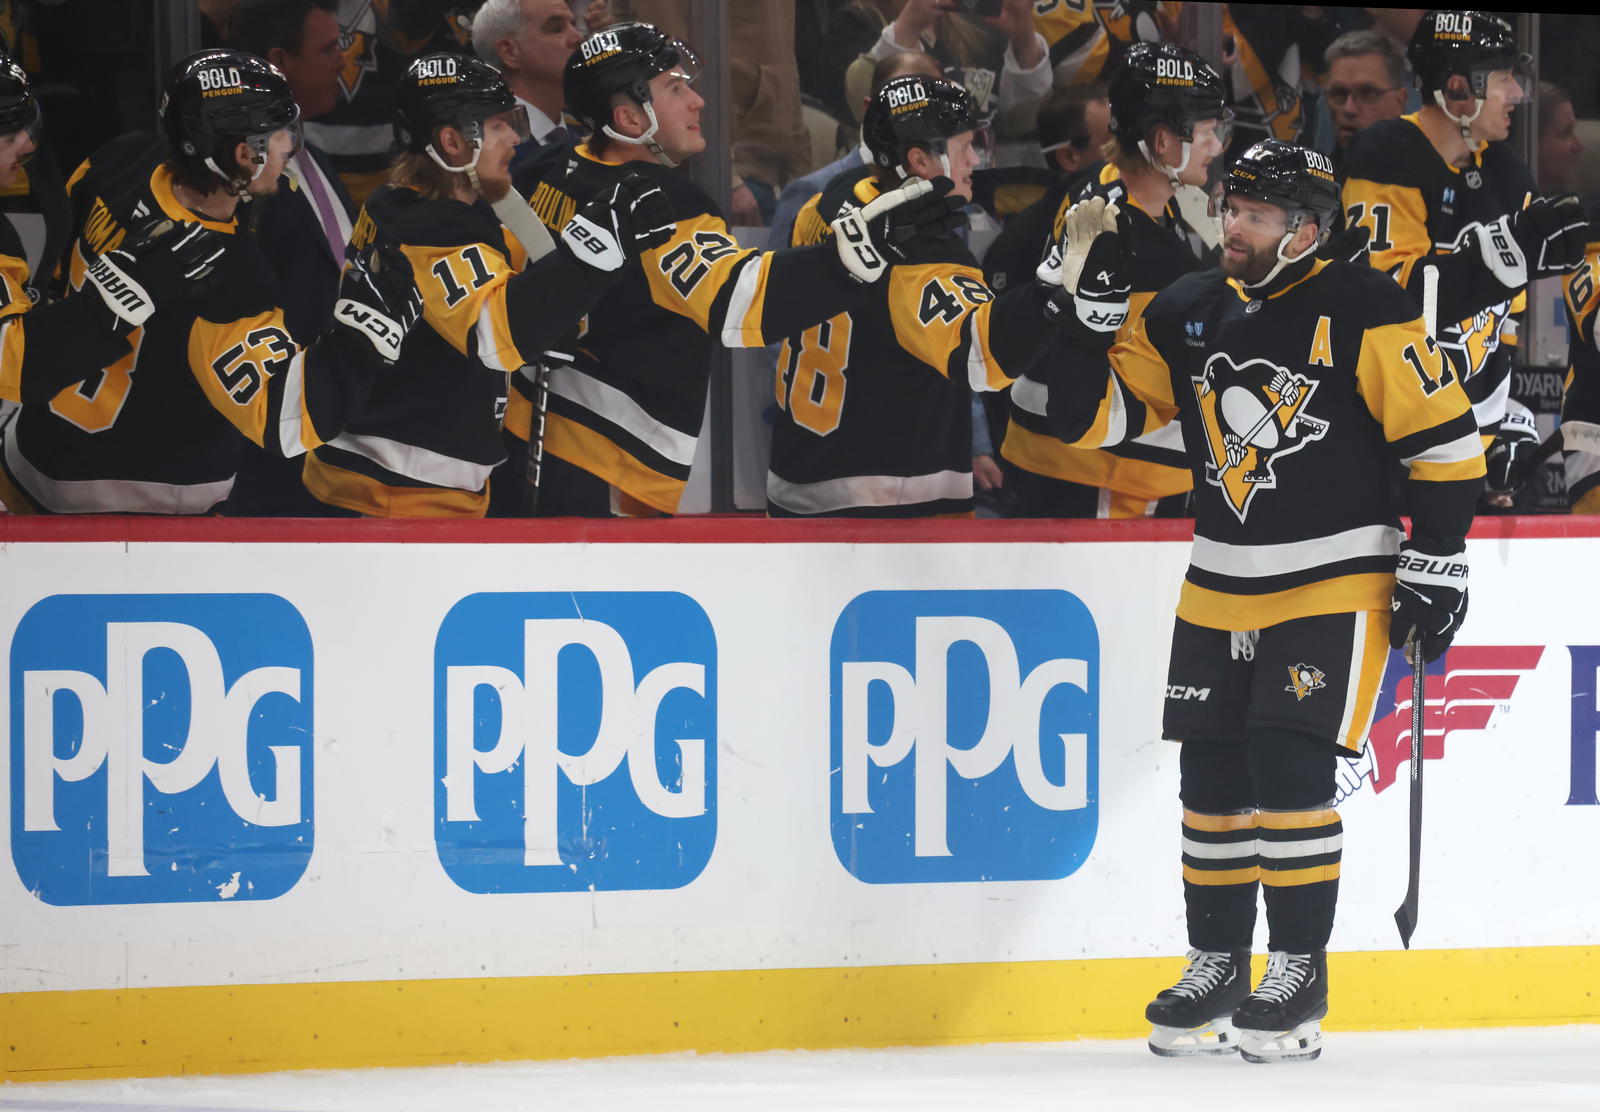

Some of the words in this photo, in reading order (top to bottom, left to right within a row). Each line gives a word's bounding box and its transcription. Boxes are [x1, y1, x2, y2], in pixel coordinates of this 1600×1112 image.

[1435, 14, 1472, 34] BOLD
[580, 32, 620, 61] BOLD
[1434, 33, 1471, 41] PENGUIN
[199, 68, 241, 91] BOLD
[417, 59, 456, 79] BOLD
[1156, 58, 1193, 80] BOLD
[202, 87, 243, 98] PENGUIN
[418, 77, 457, 86] PENGUIN
[1156, 77, 1194, 87] PENGUIN
[887, 83, 926, 108] BOLD
[890, 100, 929, 115] PENGUIN
[1304, 150, 1334, 174] BOLD
[432, 246, 496, 309] 11
[658, 231, 738, 300] 22
[918, 275, 996, 327] 48
[1308, 315, 1334, 367] A
[211, 326, 297, 406] 53
[1398, 555, 1469, 578] BAUER
[445, 618, 706, 867] PPG
[841, 615, 1088, 858] PPG
[23, 621, 302, 877] PPG
